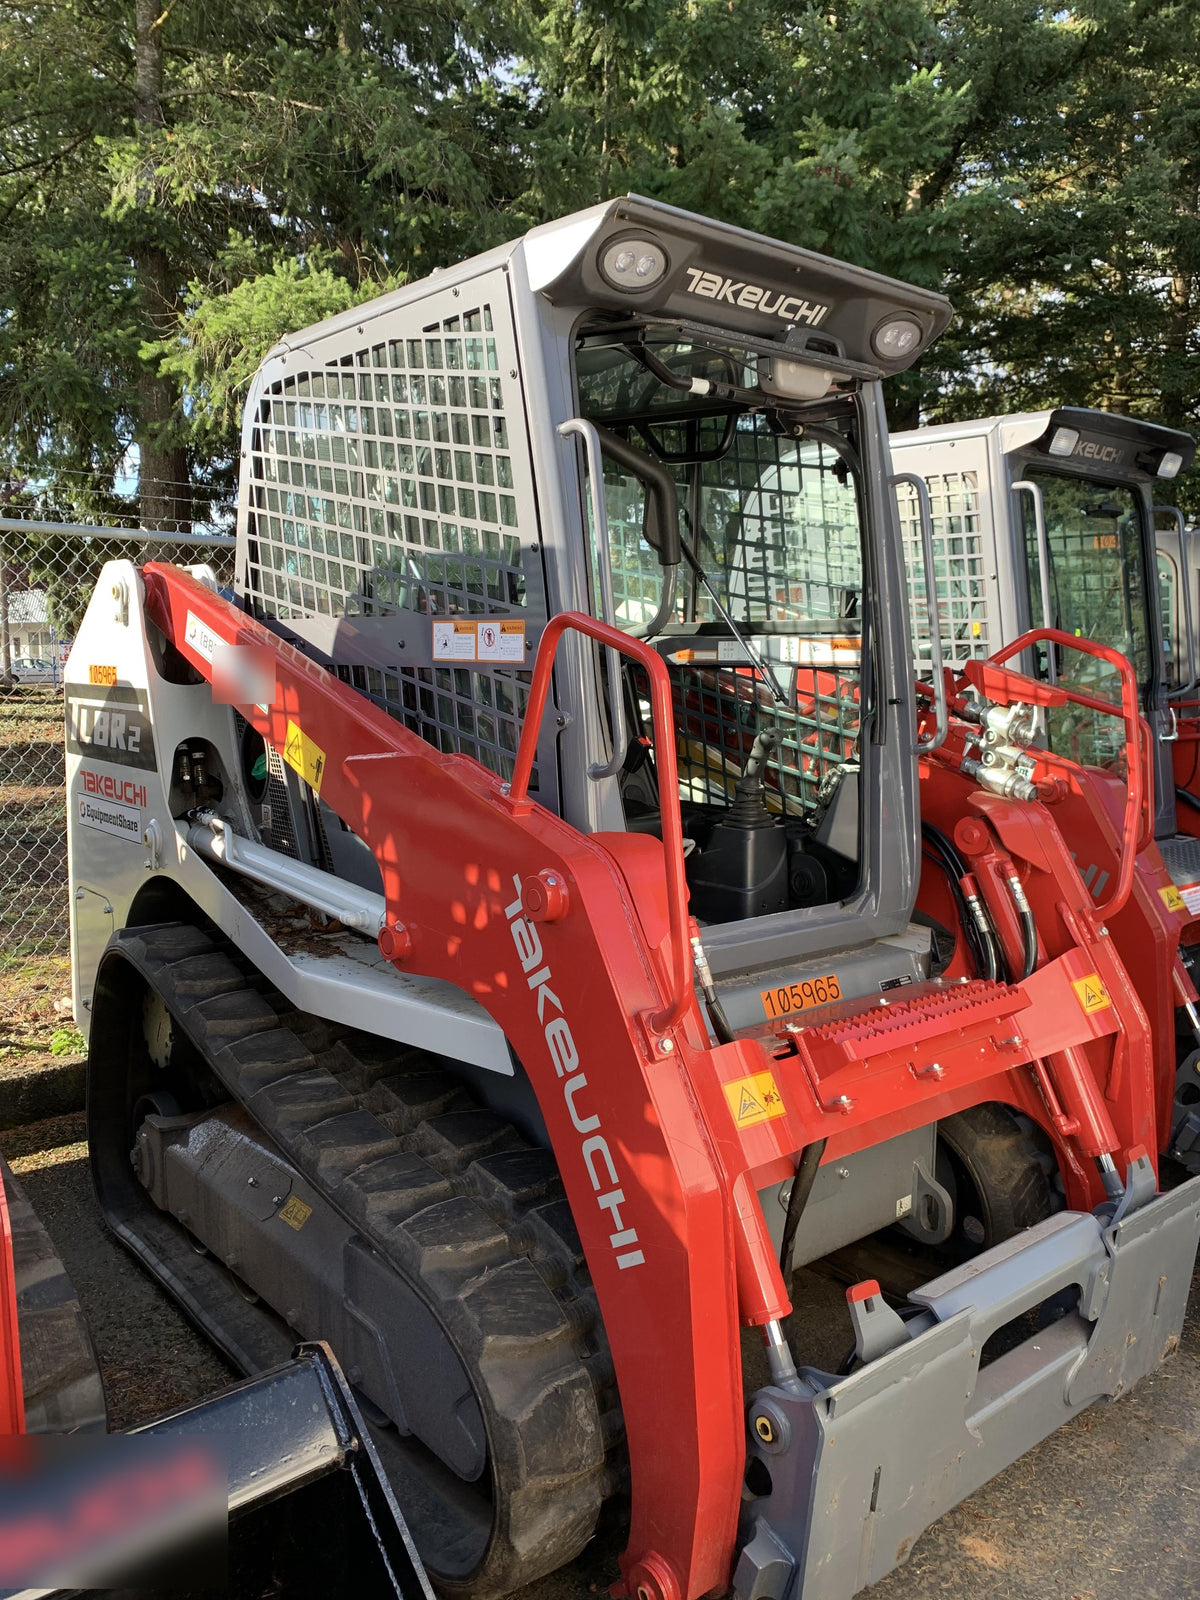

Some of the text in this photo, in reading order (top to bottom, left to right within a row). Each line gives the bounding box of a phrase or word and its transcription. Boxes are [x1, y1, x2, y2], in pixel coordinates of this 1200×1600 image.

[89, 665, 117, 685] 105965
[86, 804, 138, 832] EquipmentShare
[765, 975, 840, 1016] 105965
